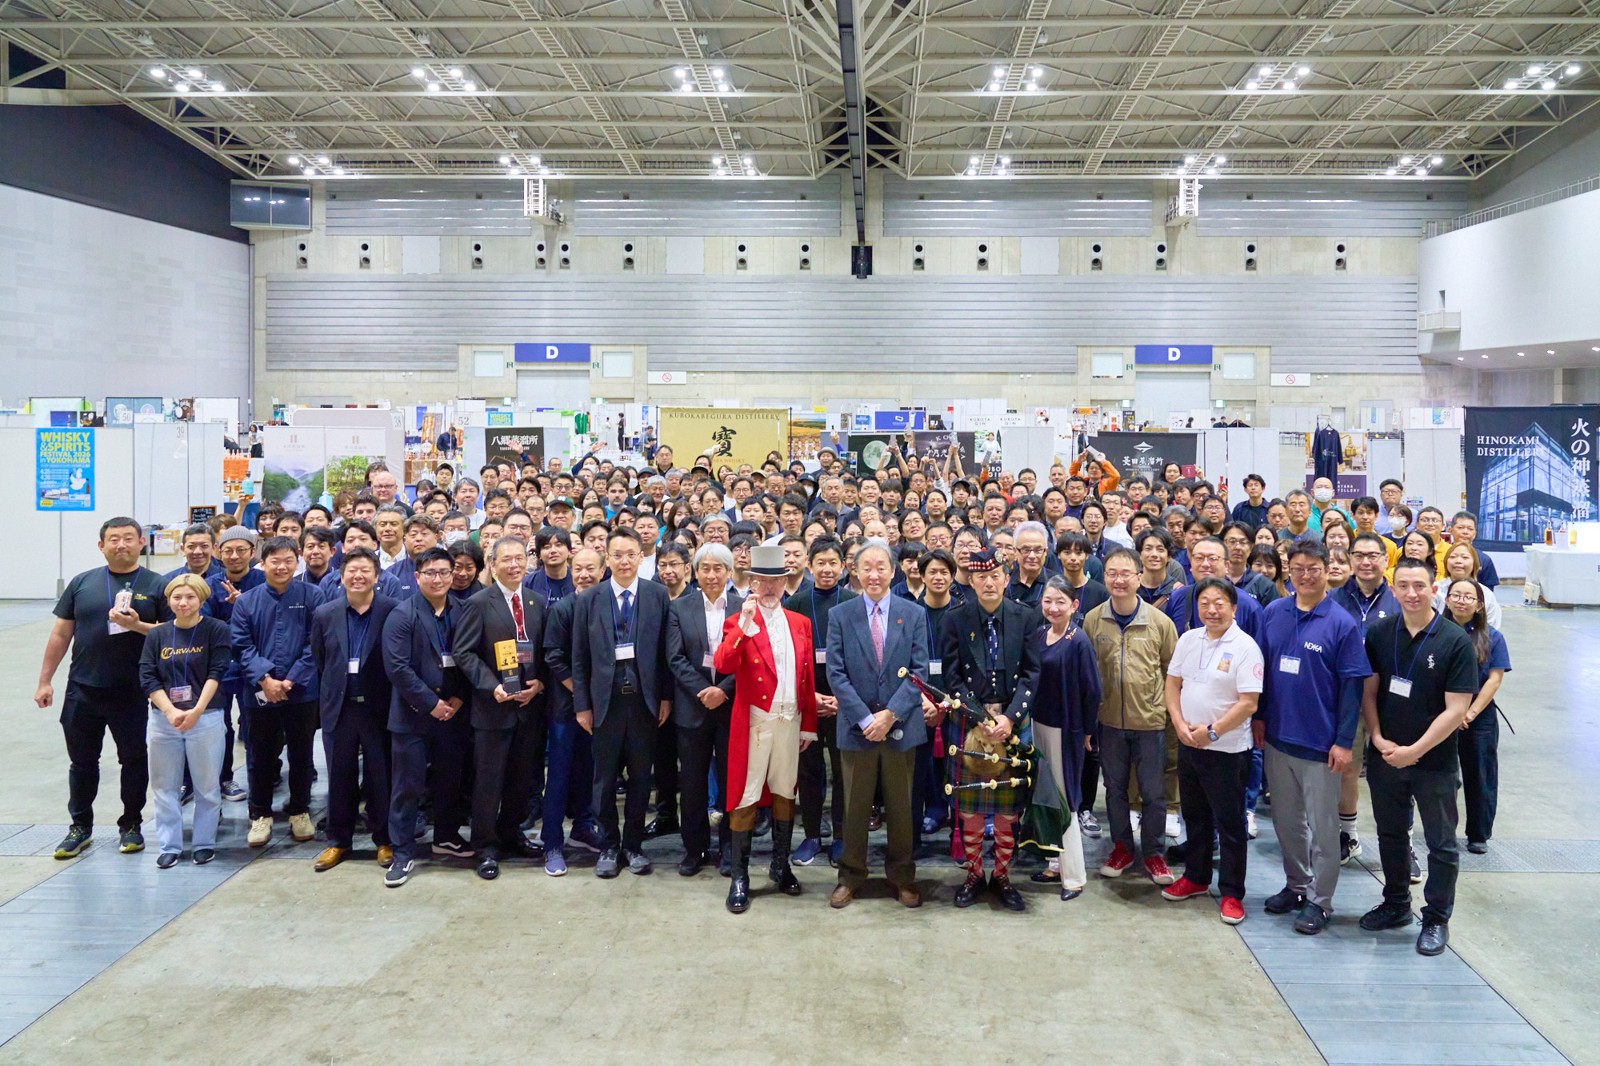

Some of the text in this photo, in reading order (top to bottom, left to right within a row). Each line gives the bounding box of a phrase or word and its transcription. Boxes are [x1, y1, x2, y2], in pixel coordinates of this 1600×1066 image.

[545, 346, 559, 359] D
[1168, 347, 1181, 361] D
[122, 412, 131, 421] 50
[458, 416, 470, 426] 52
[669, 412, 732, 420] KUROKABEGURA
[41, 432, 90, 442] WHISKY
[176, 426, 185, 439] 39
[1477, 435, 1540, 445] HINOKAMI
[1477, 447, 1545, 457] DISTILLERY
[161, 646, 203, 660] CARVAAN
